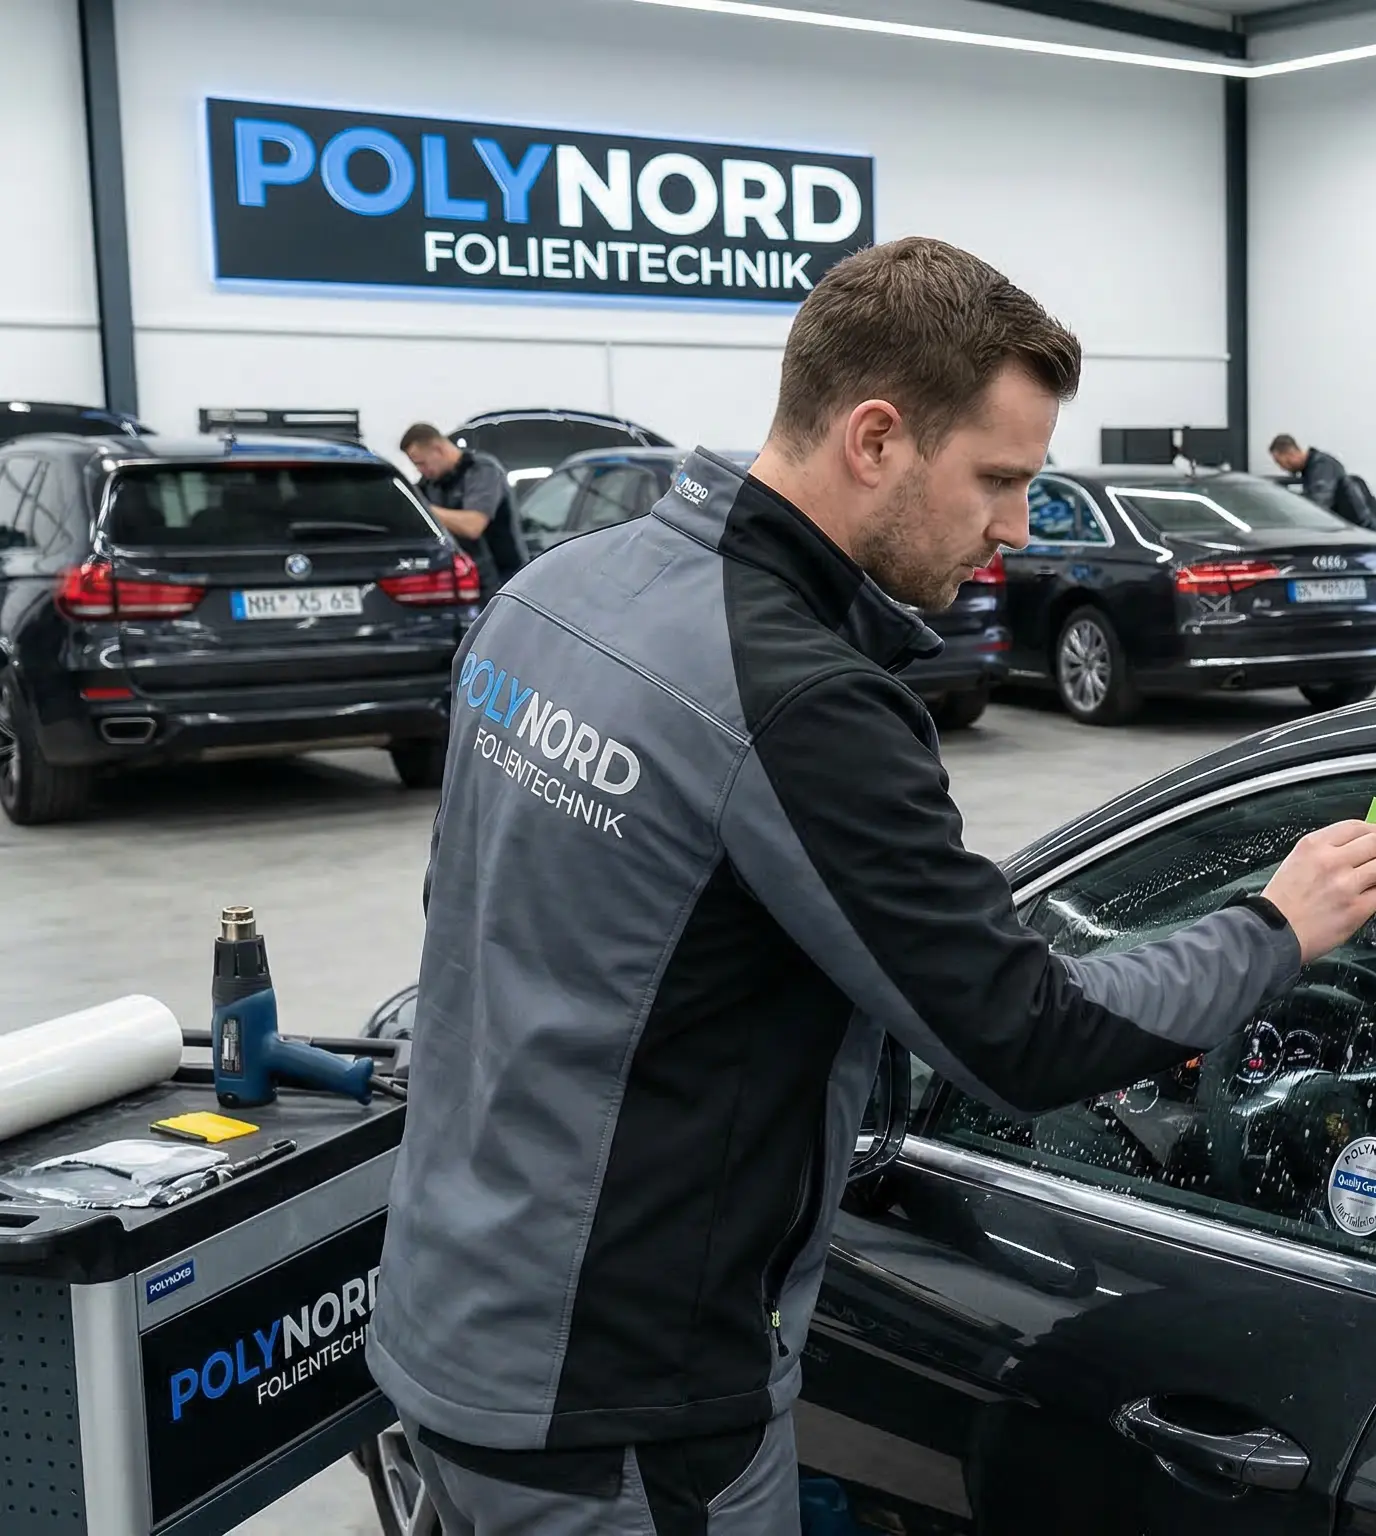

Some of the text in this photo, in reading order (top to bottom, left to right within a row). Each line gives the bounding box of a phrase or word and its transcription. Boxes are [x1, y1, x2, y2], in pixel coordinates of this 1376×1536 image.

[234, 116, 863, 243] POLYNORD
[424, 231, 814, 291] FOLIENTECHNIK
[459, 652, 641, 795] POLYNORD
[474, 727, 627, 839] FOLIENTECHNIK
